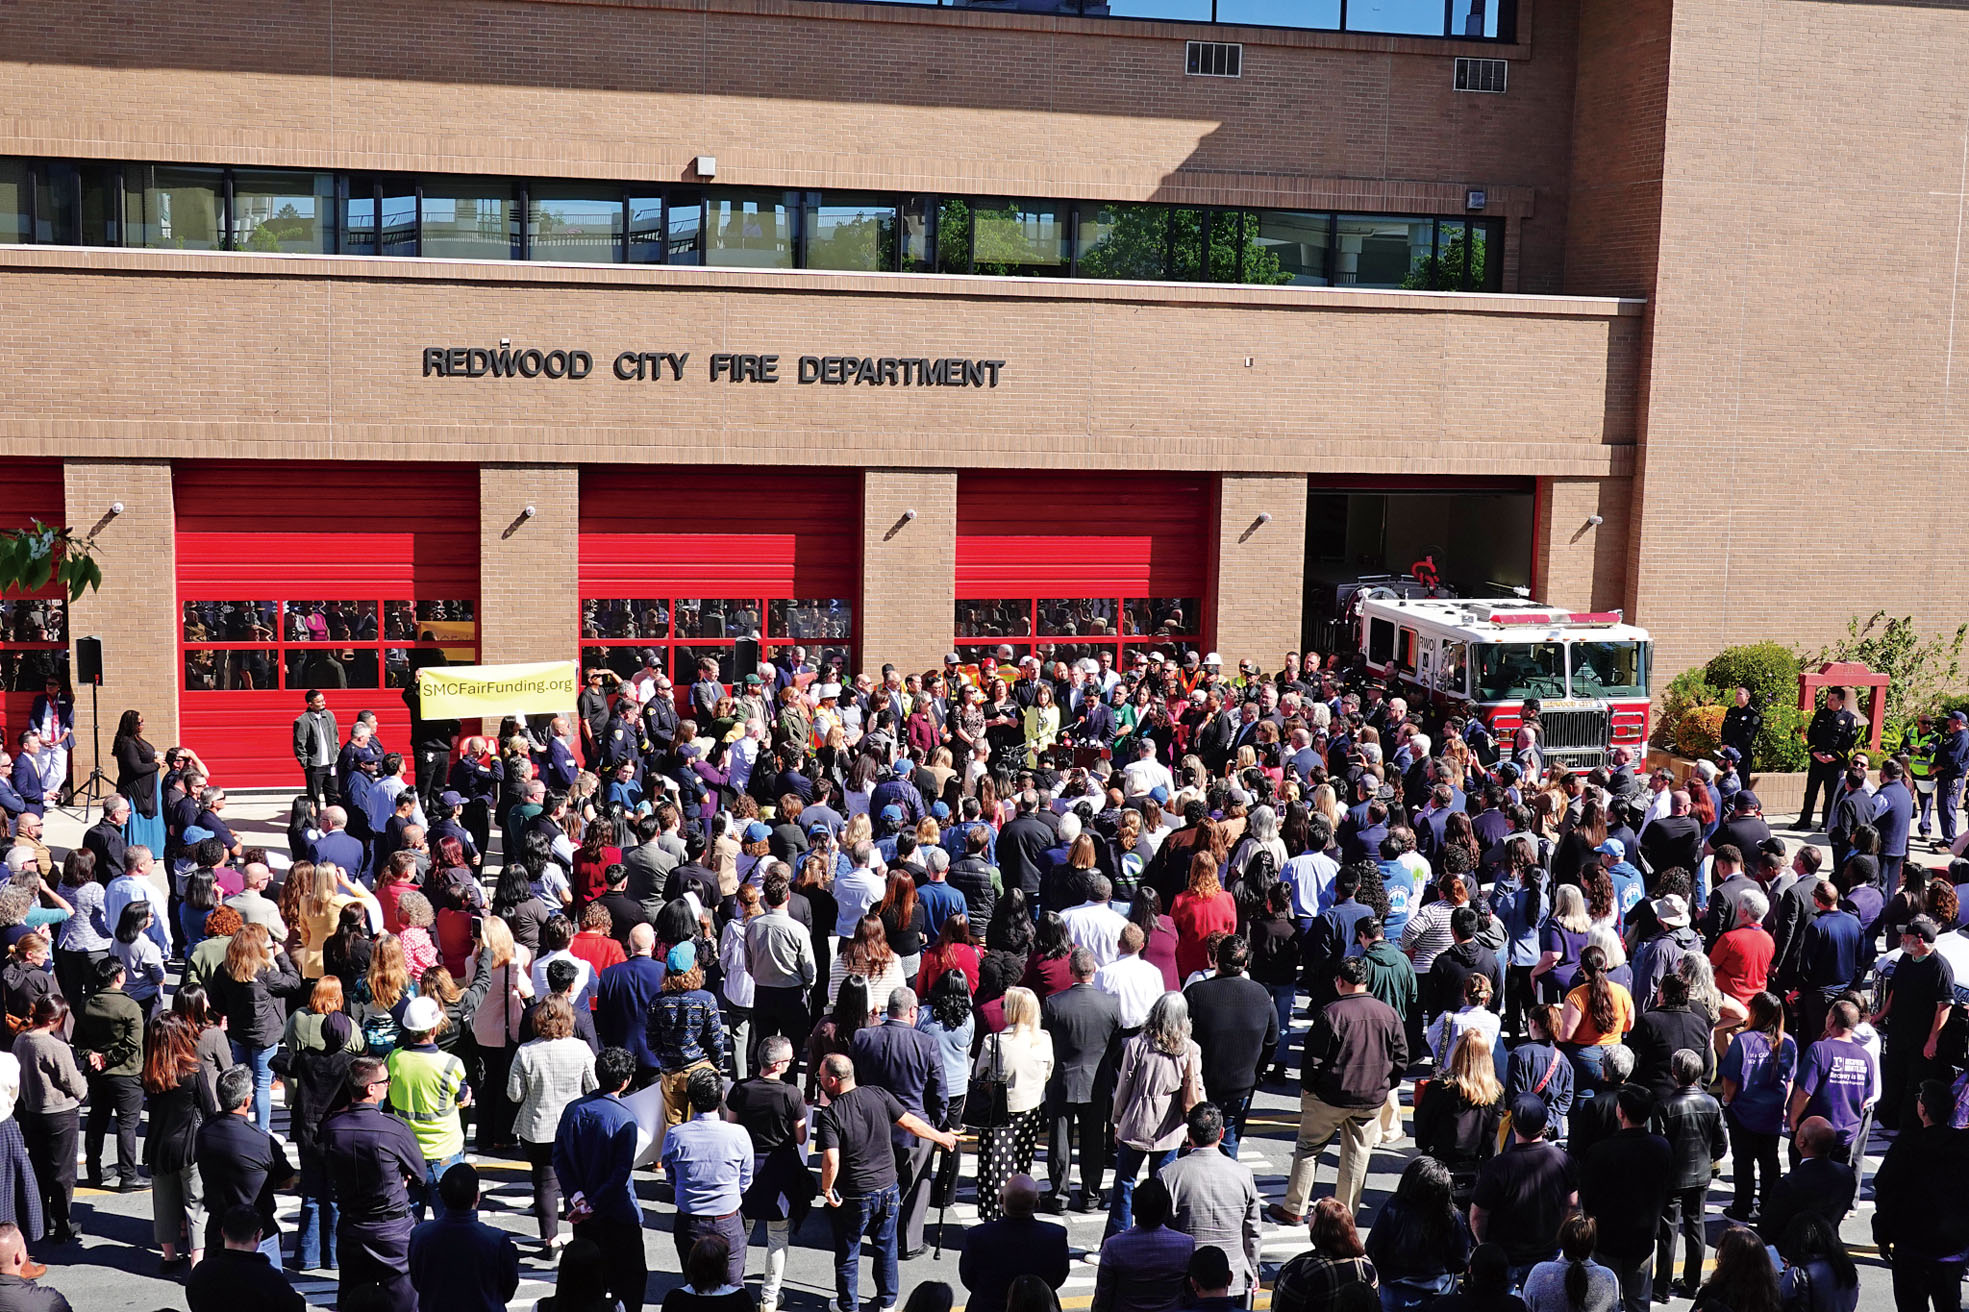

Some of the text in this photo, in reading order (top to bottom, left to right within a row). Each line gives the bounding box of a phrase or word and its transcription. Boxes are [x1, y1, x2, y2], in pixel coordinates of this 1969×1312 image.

[423, 347, 1006, 388] REDWOOD CITY FIRE DEPARTMENT
[423, 679, 573, 697] SMCFairFunding.org
